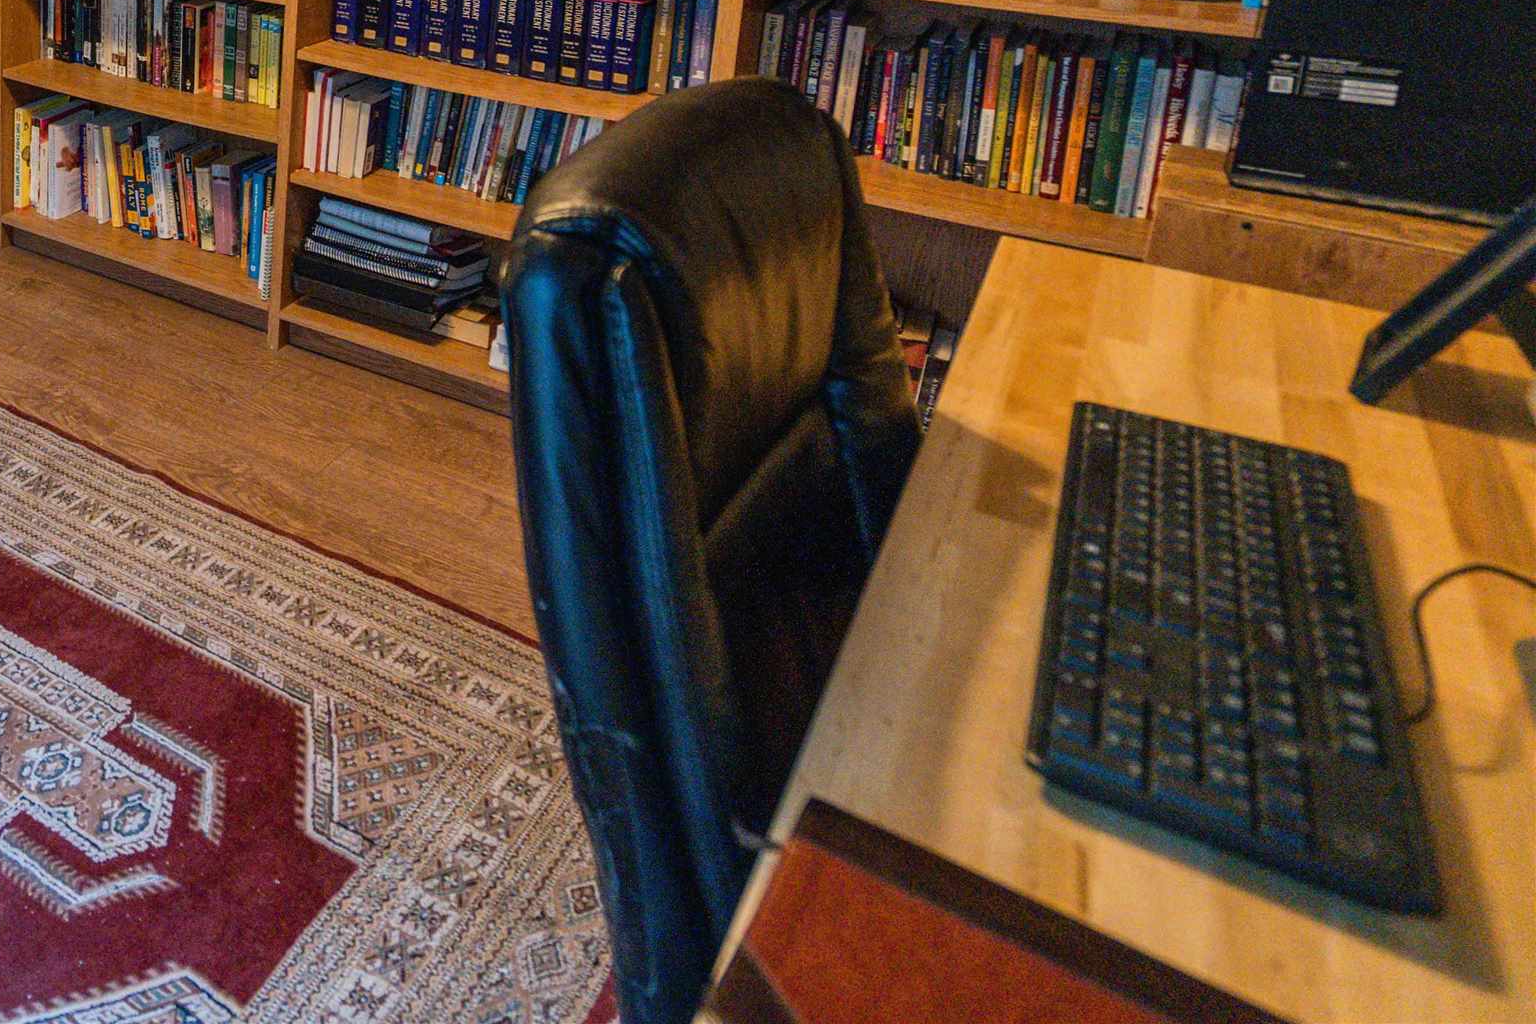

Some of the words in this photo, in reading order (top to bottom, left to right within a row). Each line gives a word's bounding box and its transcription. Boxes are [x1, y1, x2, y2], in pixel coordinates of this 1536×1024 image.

[574, 0, 585, 35] DICTIONARY
[601, 2, 613, 40] DICTIONARY
[615, 2, 627, 40] TESTAMENT
[626, 3, 638, 41] DICTIONARY
[126, 180, 135, 207] ITALY
